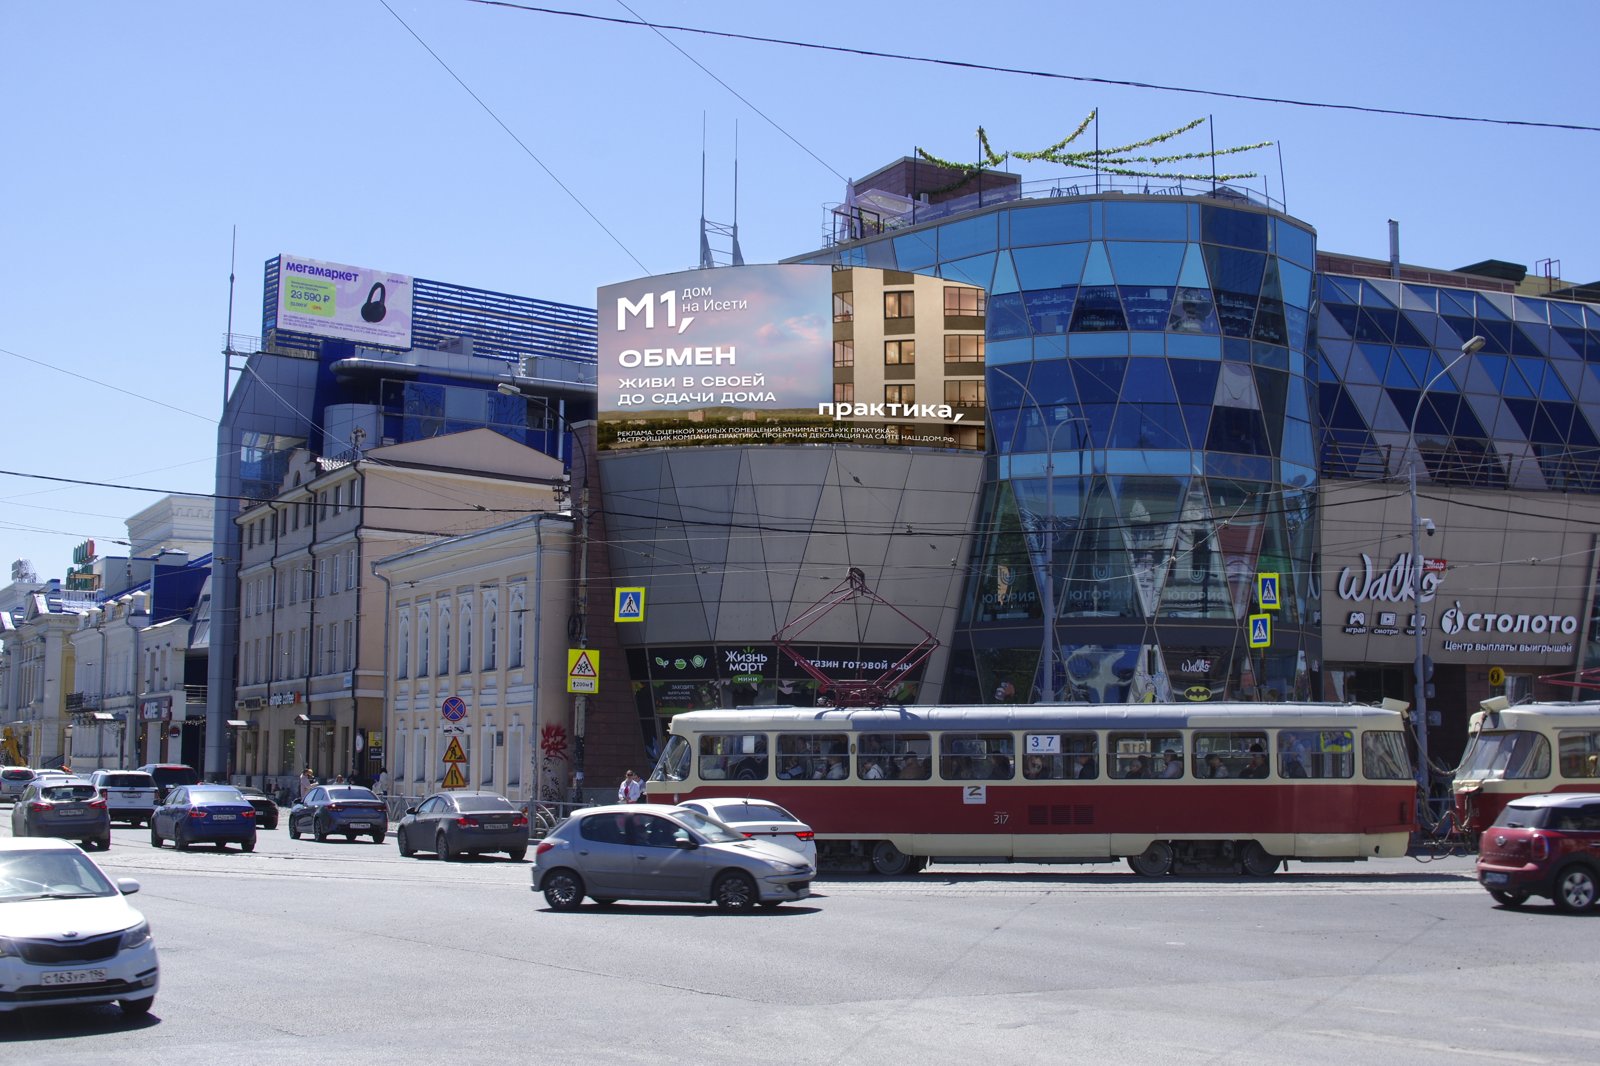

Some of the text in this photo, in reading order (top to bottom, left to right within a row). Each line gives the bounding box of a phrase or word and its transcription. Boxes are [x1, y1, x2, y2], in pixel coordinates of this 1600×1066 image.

[286, 262, 359, 282] мегамаркет
[291, 290, 302, 299] 23
[304, 292, 321, 302] 590
[682, 286, 712, 300] дом
[682, 299, 747, 312] на Исети
[618, 346, 736, 368] ОБМЕН
[618, 373, 765, 388] ЖИВИ В СВОЕЙ
[618, 392, 776, 406] ДО СДАЧИ ДОМА
[818, 402, 964, 423] практика,
[656, 428, 694, 436] ОЦЕНКОЙ
[617, 435, 671, 443] ЗАСТРОЙЩИК
[1345, 627, 1366, 635] играй
[1445, 641, 1572, 654] Центр выплаты выигрышей
[725, 651, 768, 662] Жизнь
[729, 662, 764, 674] март
[843, 660, 888, 669] готовой
[967, 785, 982, 796] Z
[993, 814, 1009, 824] 317
